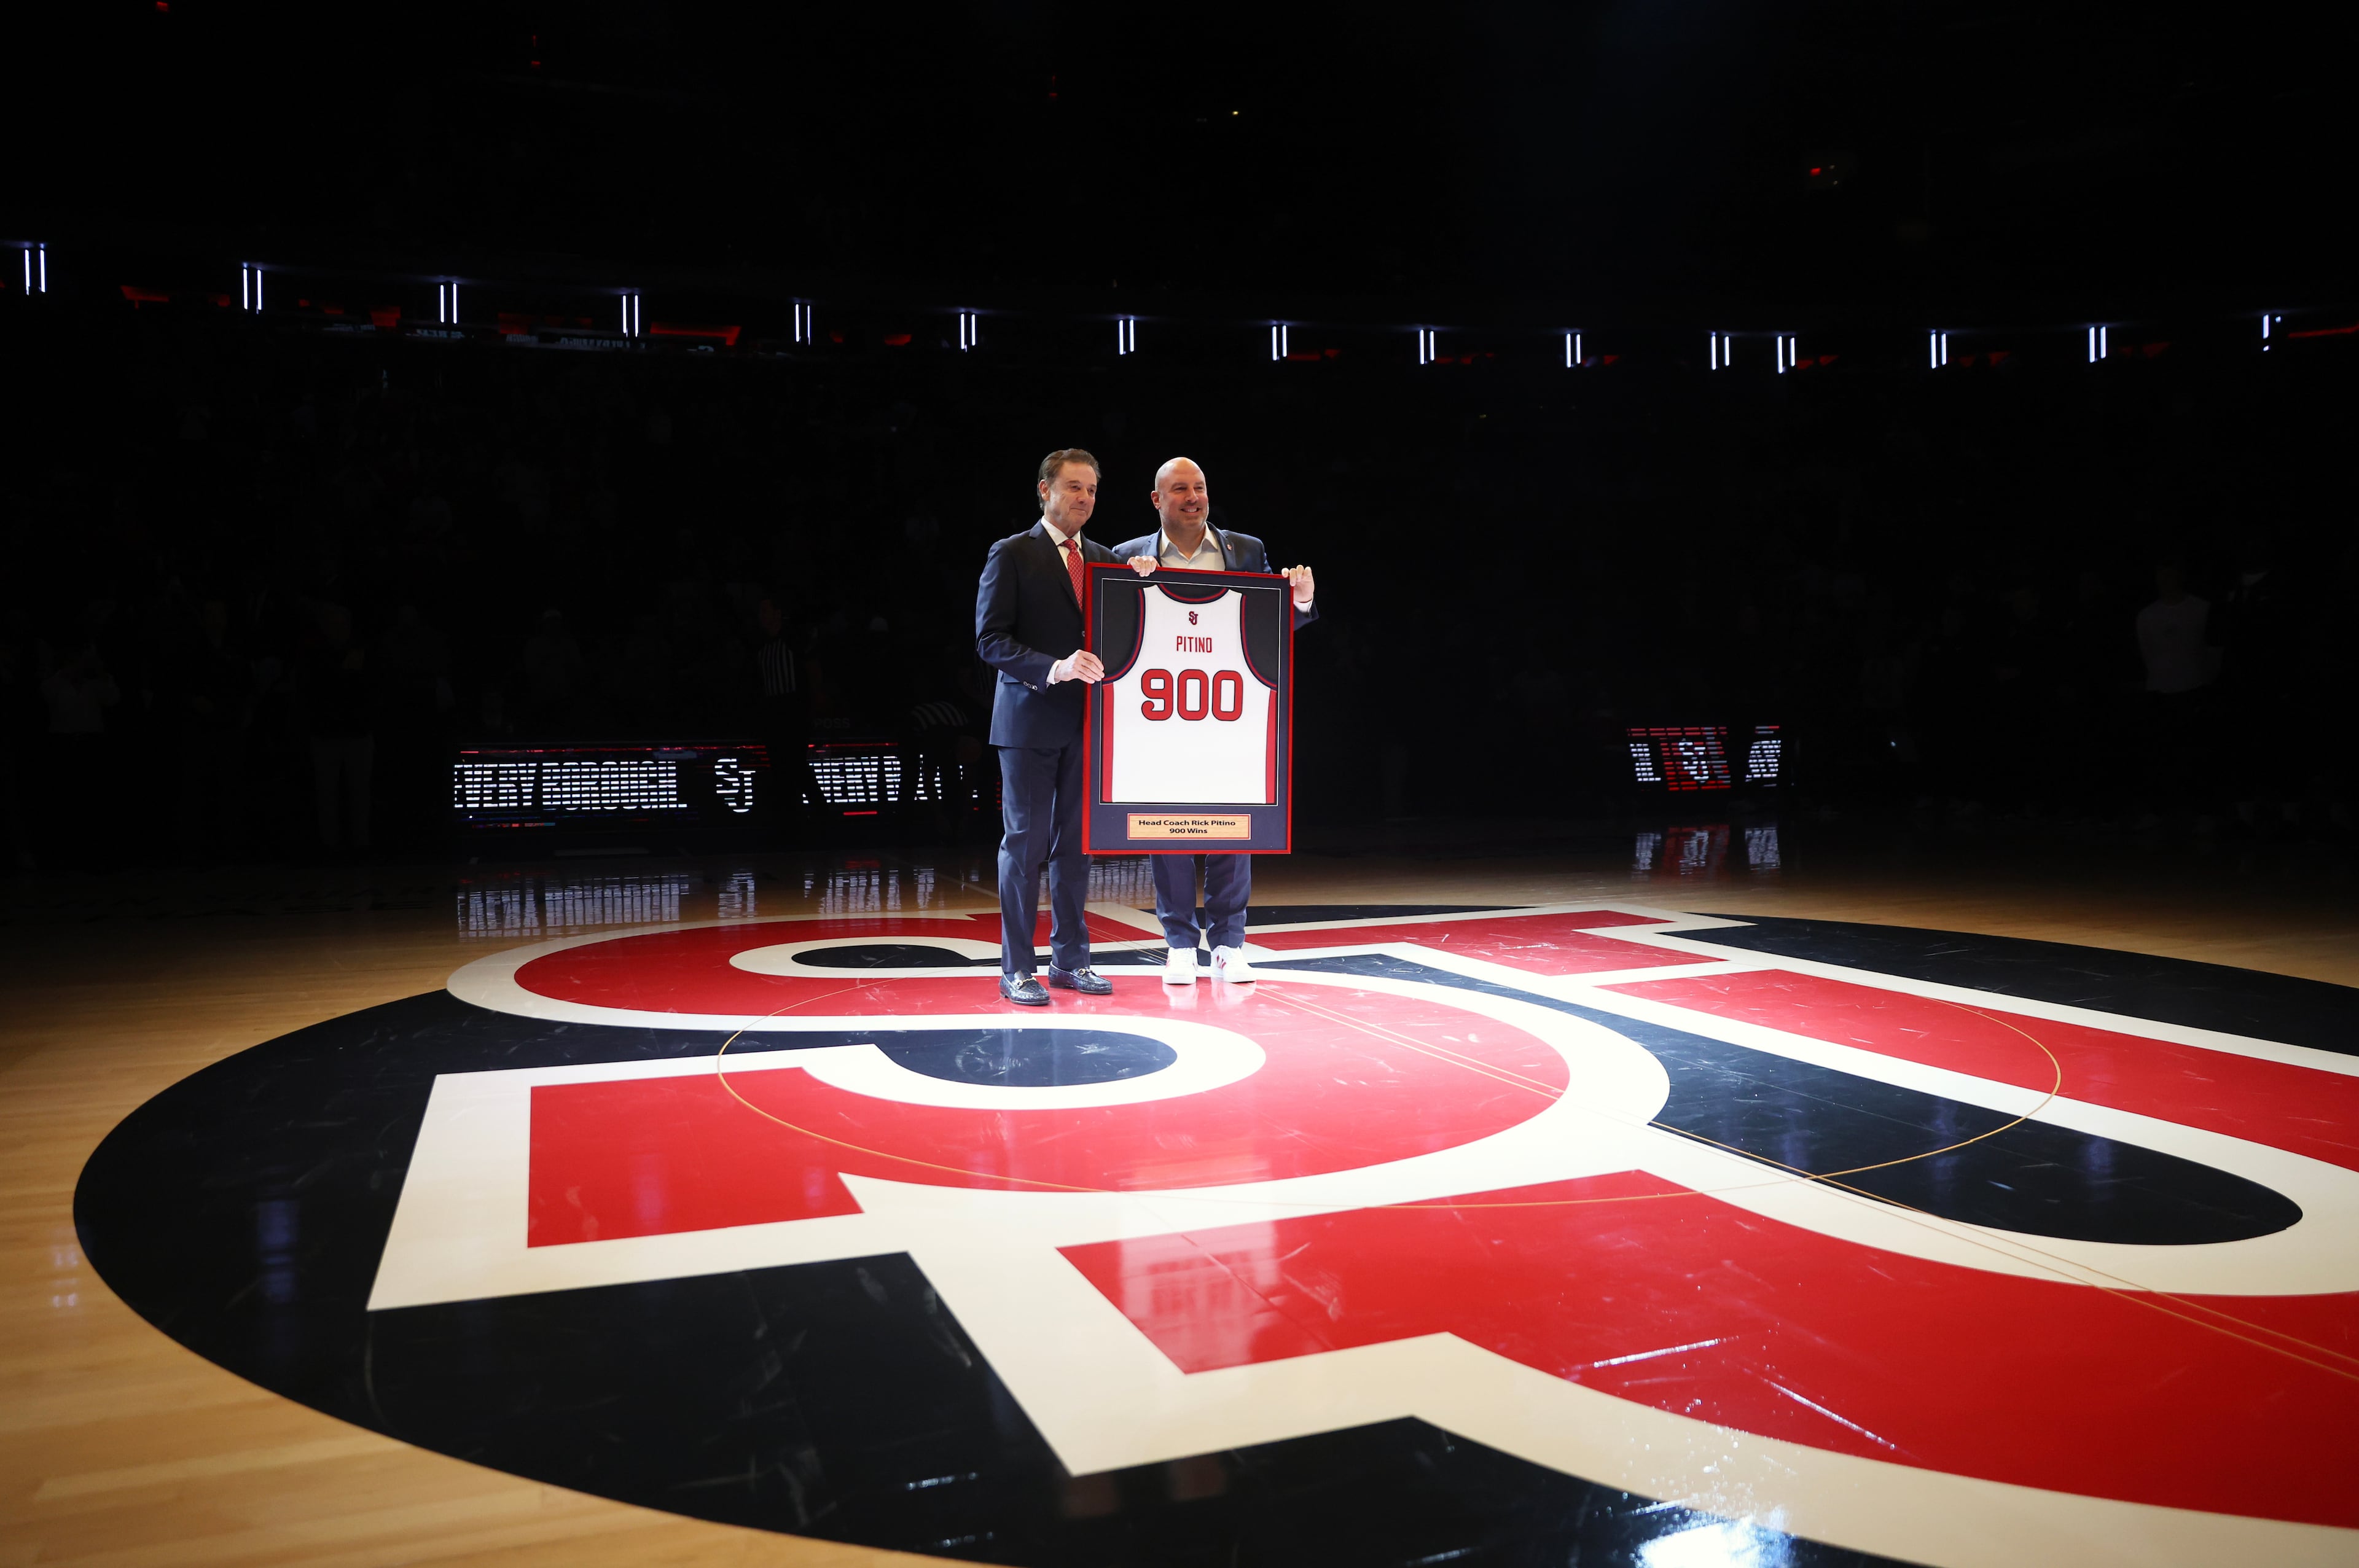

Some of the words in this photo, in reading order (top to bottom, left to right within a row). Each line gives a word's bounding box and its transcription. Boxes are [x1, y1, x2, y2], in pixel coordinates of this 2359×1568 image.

[1176, 636, 1212, 652] PITINO
[1141, 669, 1243, 721] 900
[454, 763, 537, 808] EVERY
[802, 755, 878, 803] VERY
